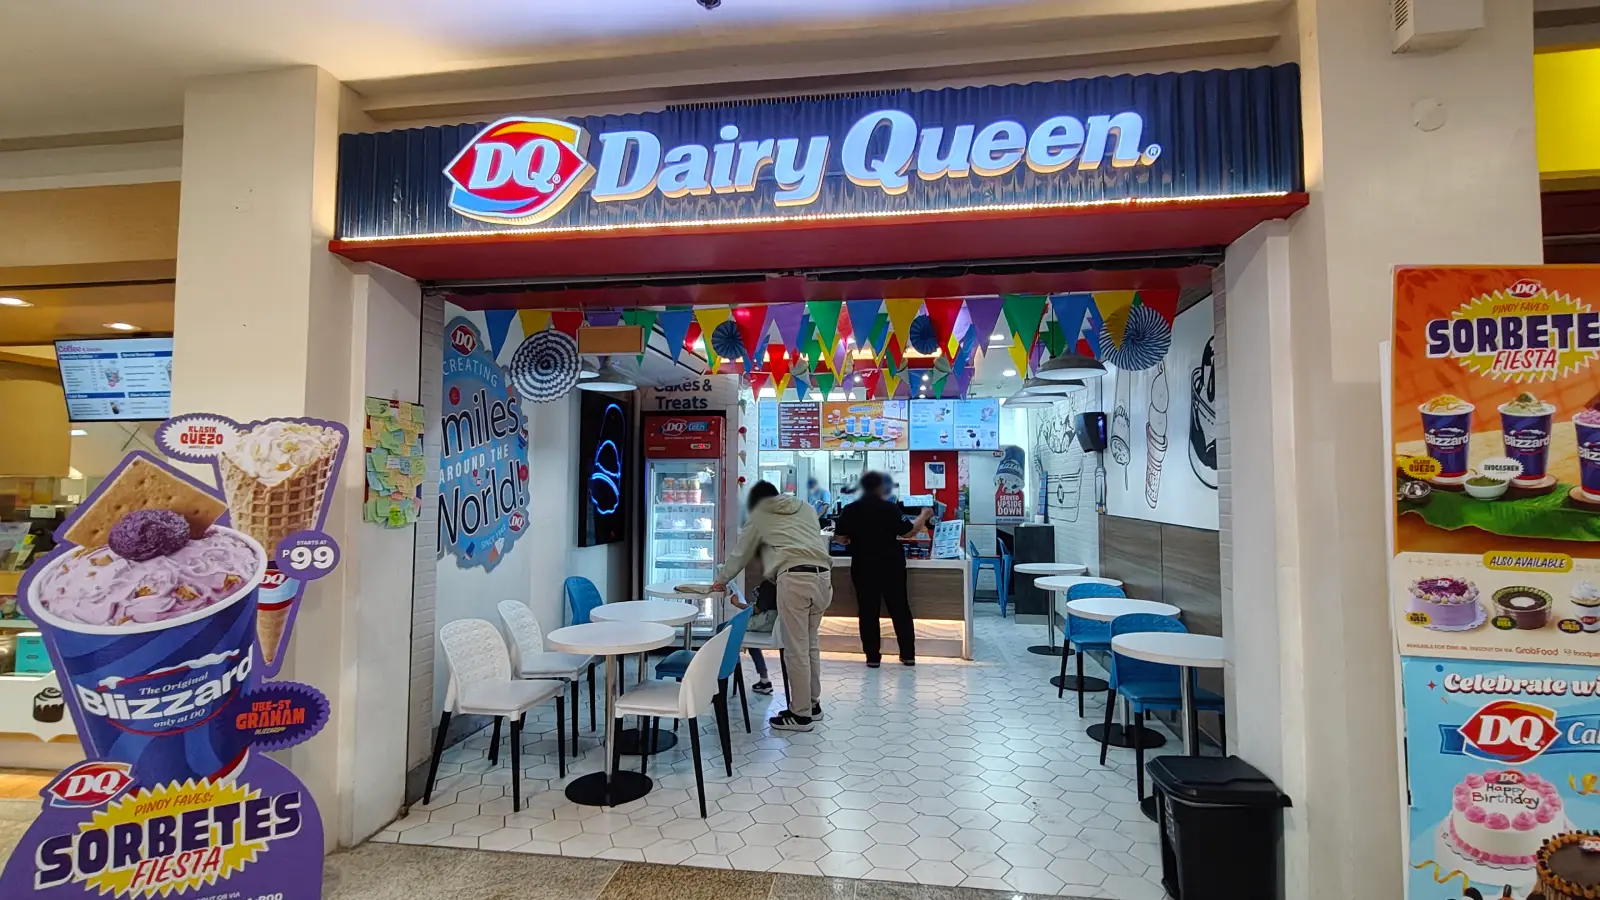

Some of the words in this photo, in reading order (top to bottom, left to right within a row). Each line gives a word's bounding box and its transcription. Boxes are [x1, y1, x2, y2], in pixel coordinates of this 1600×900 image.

[469, 138, 561, 193] DQ
[591, 125, 830, 205] Dairy
[842, 110, 1143, 193] Queen
[1516, 283, 1537, 294] DQ
[1492, 303, 1518, 314] PINOY
[455, 330, 473, 352] DQ
[1492, 348, 1557, 371] FIESTA
[443, 357, 499, 388] CREATING
[702, 378, 712, 392] &
[655, 396, 708, 410] Treats
[667, 422, 683, 432] DQ
[180, 433, 224, 445] QUEZO
[1424, 432, 1469, 446] Blizzard
[1504, 434, 1550, 448] Blizzard
[439, 453, 485, 484] AROUND
[490, 444, 508, 462] THE
[997, 500, 1022, 508] UPSIDE
[997, 507, 1022, 516] DOWN
[511, 515, 523, 529] DQ
[1490, 556, 1514, 567] ALSO
[1514, 557, 1566, 569] AVAILABLE
[262, 573, 285, 585] DQ
[1515, 646, 1559, 656] GrabFood
[76, 643, 253, 720] Blizzard
[139, 685, 160, 696] The
[162, 671, 208, 692] Original
[1444, 673, 1567, 696] Celebrate
[252, 699, 291, 712] UBE-ST
[153, 717, 176, 729] only
[177, 713, 189, 724] at
[189, 708, 206, 721] DQ
[236, 708, 305, 729] GRAHAM
[1477, 714, 1544, 751] DQ
[66, 771, 121, 798] DQ
[1500, 773, 1517, 783] DQ
[1486, 783, 1526, 796] Happy
[134, 797, 172, 817] PINOY
[1472, 791, 1540, 810] Birthday
[36, 791, 302, 888] SORBETES
[131, 846, 223, 889] FIESTA
